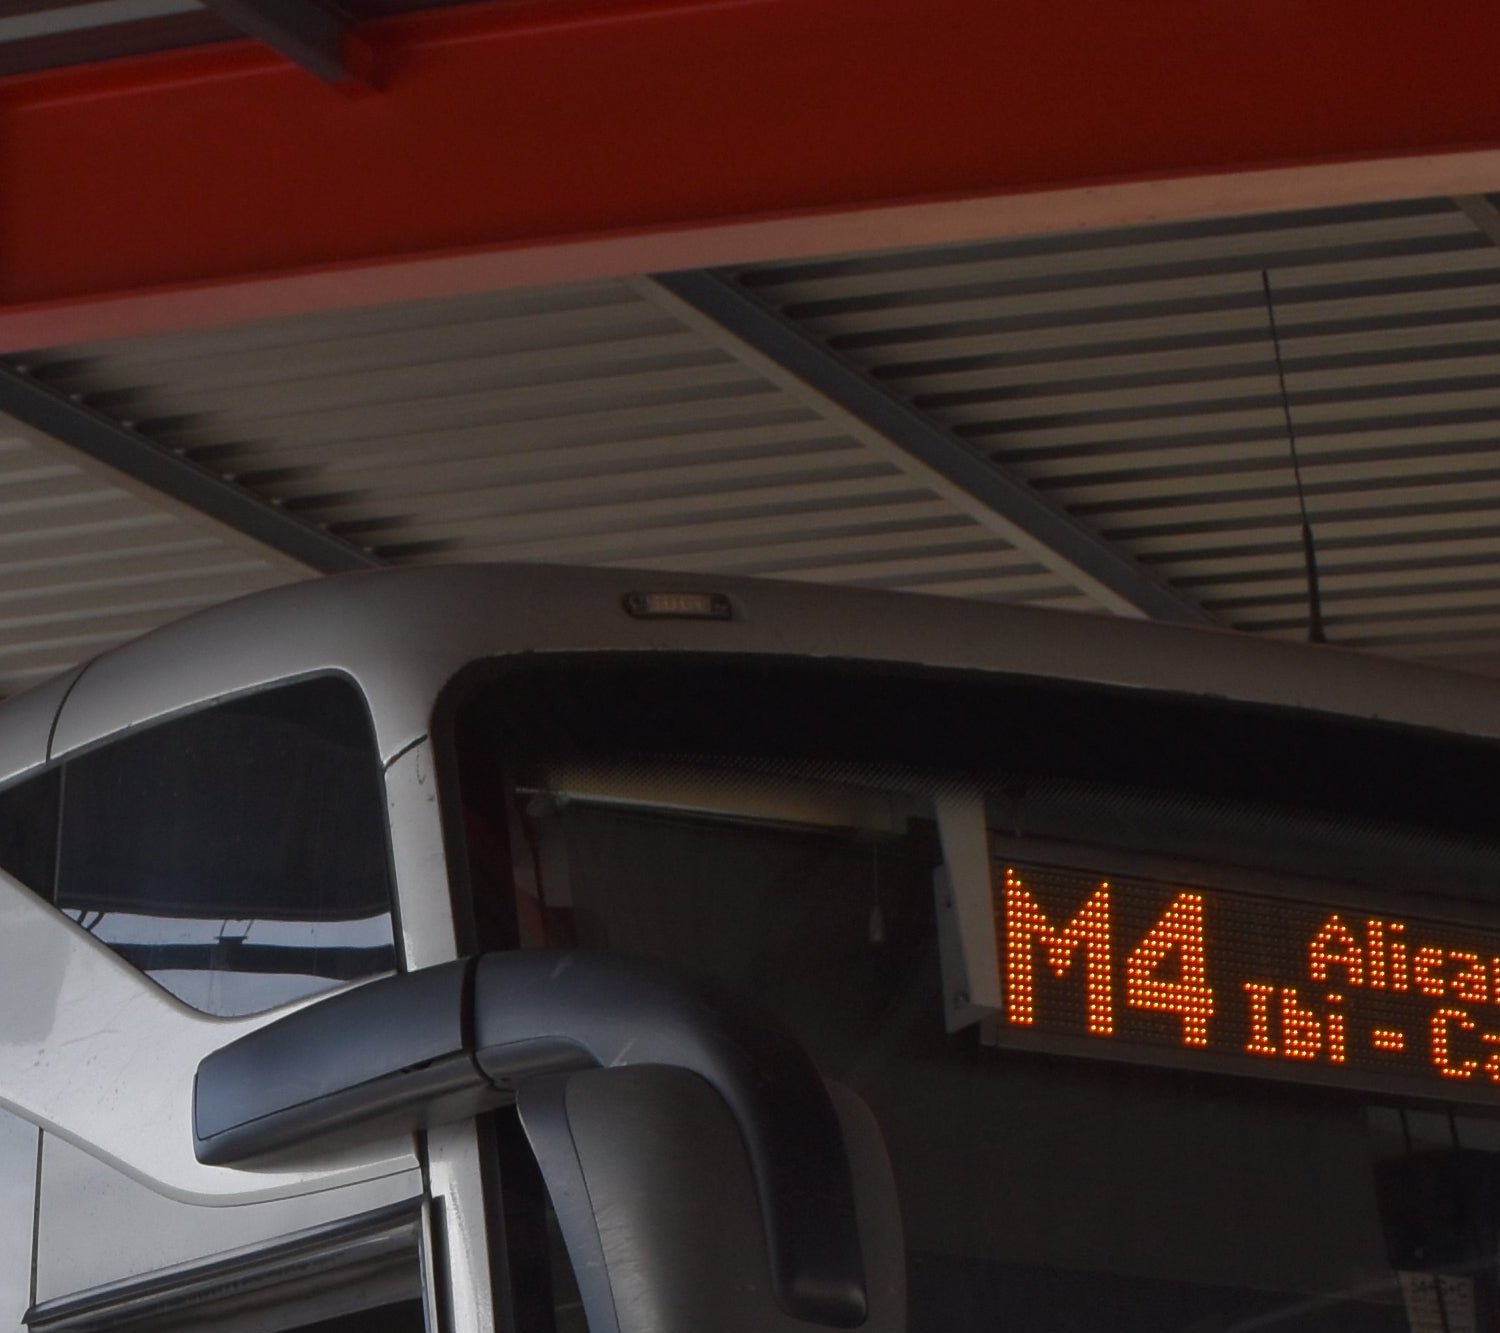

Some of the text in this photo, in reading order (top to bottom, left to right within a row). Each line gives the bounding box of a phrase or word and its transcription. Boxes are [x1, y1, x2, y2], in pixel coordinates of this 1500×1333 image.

[1005, 868, 1213, 1046] M4
[1242, 979, 1347, 1065] Ibi
[1373, 1029, 1403, 1050] -
